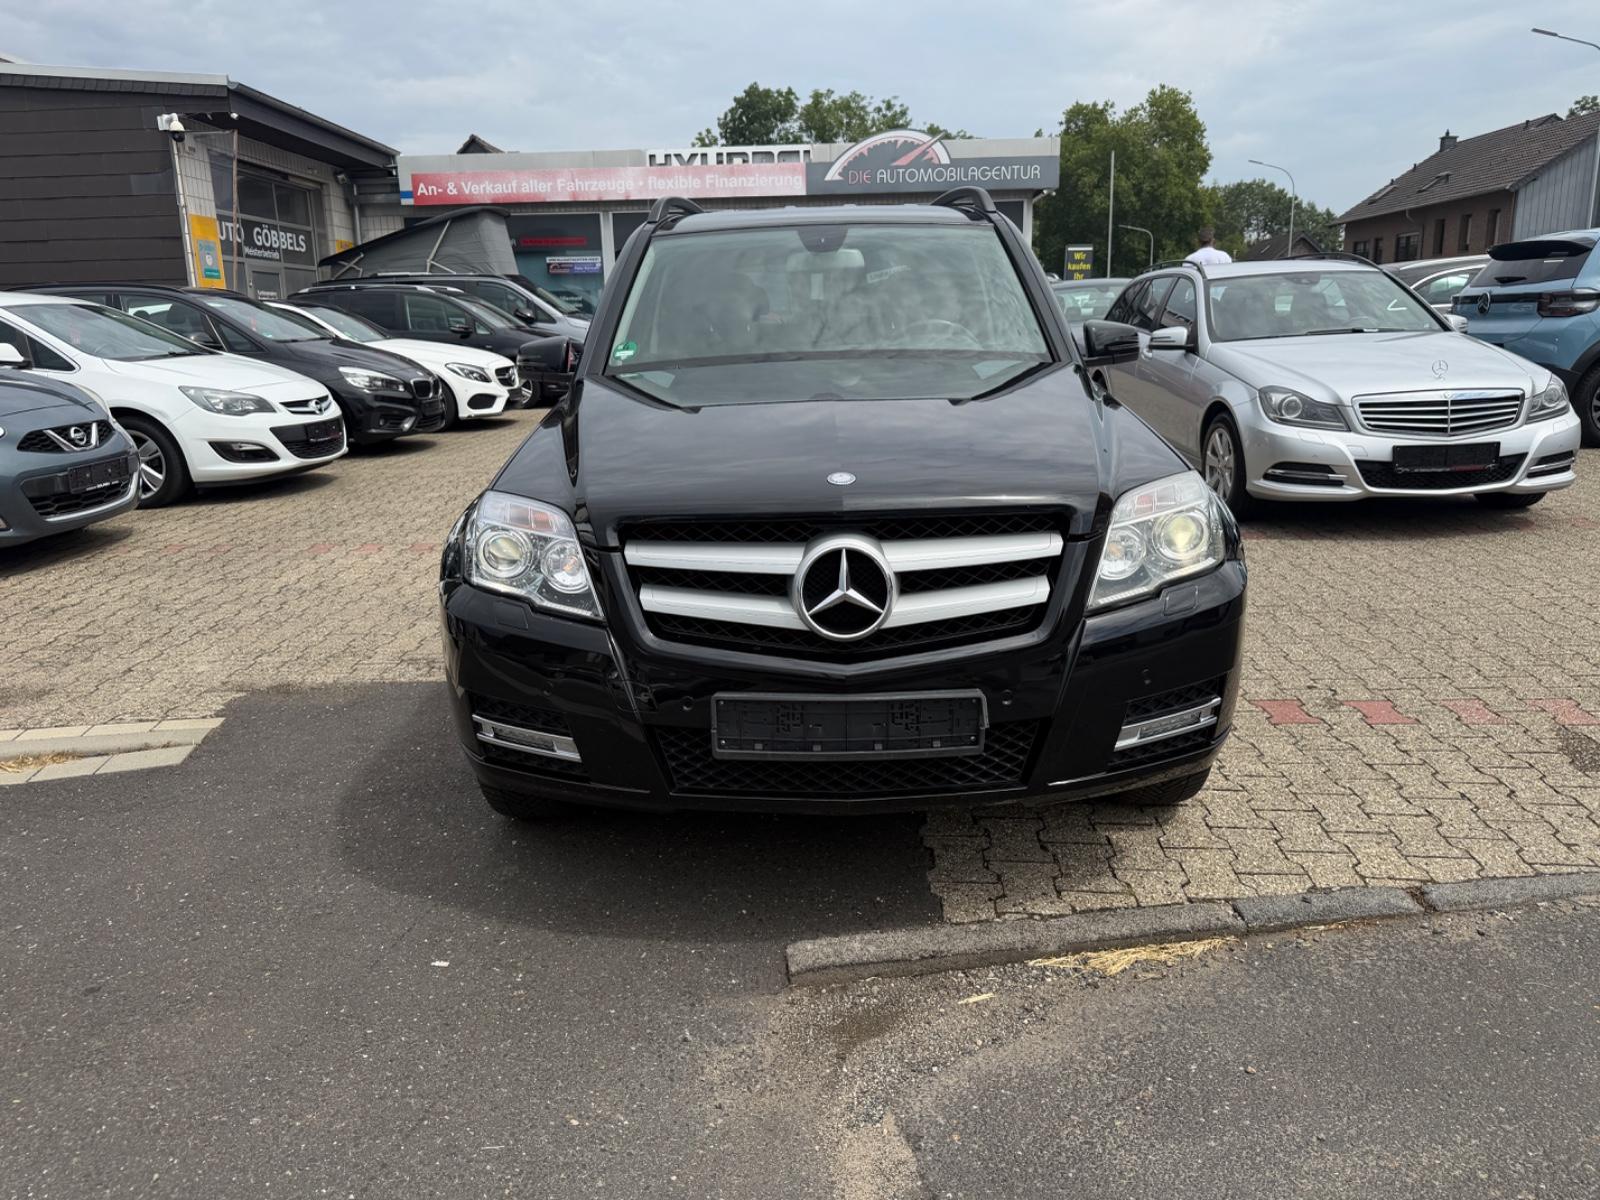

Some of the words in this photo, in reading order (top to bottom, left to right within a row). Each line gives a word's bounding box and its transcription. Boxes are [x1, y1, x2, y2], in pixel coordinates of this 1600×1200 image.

[417, 183, 443, 196] An-
[447, 182, 458, 195] &
[461, 179, 518, 195] Verkauf
[521, 179, 551, 193] aller
[557, 177, 635, 193] Fahrzeuge
[648, 175, 700, 190] flexible
[705, 173, 803, 189] Finanzierung
[848, 169, 872, 185] DIE
[877, 164, 1041, 184] AUTOMOBILAGENTUR
[219, 221, 245, 243] UTO
[253, 224, 307, 252] GÖBBELS
[1067, 261, 1091, 270] kaufen
[1073, 251, 1087, 260] Wir
